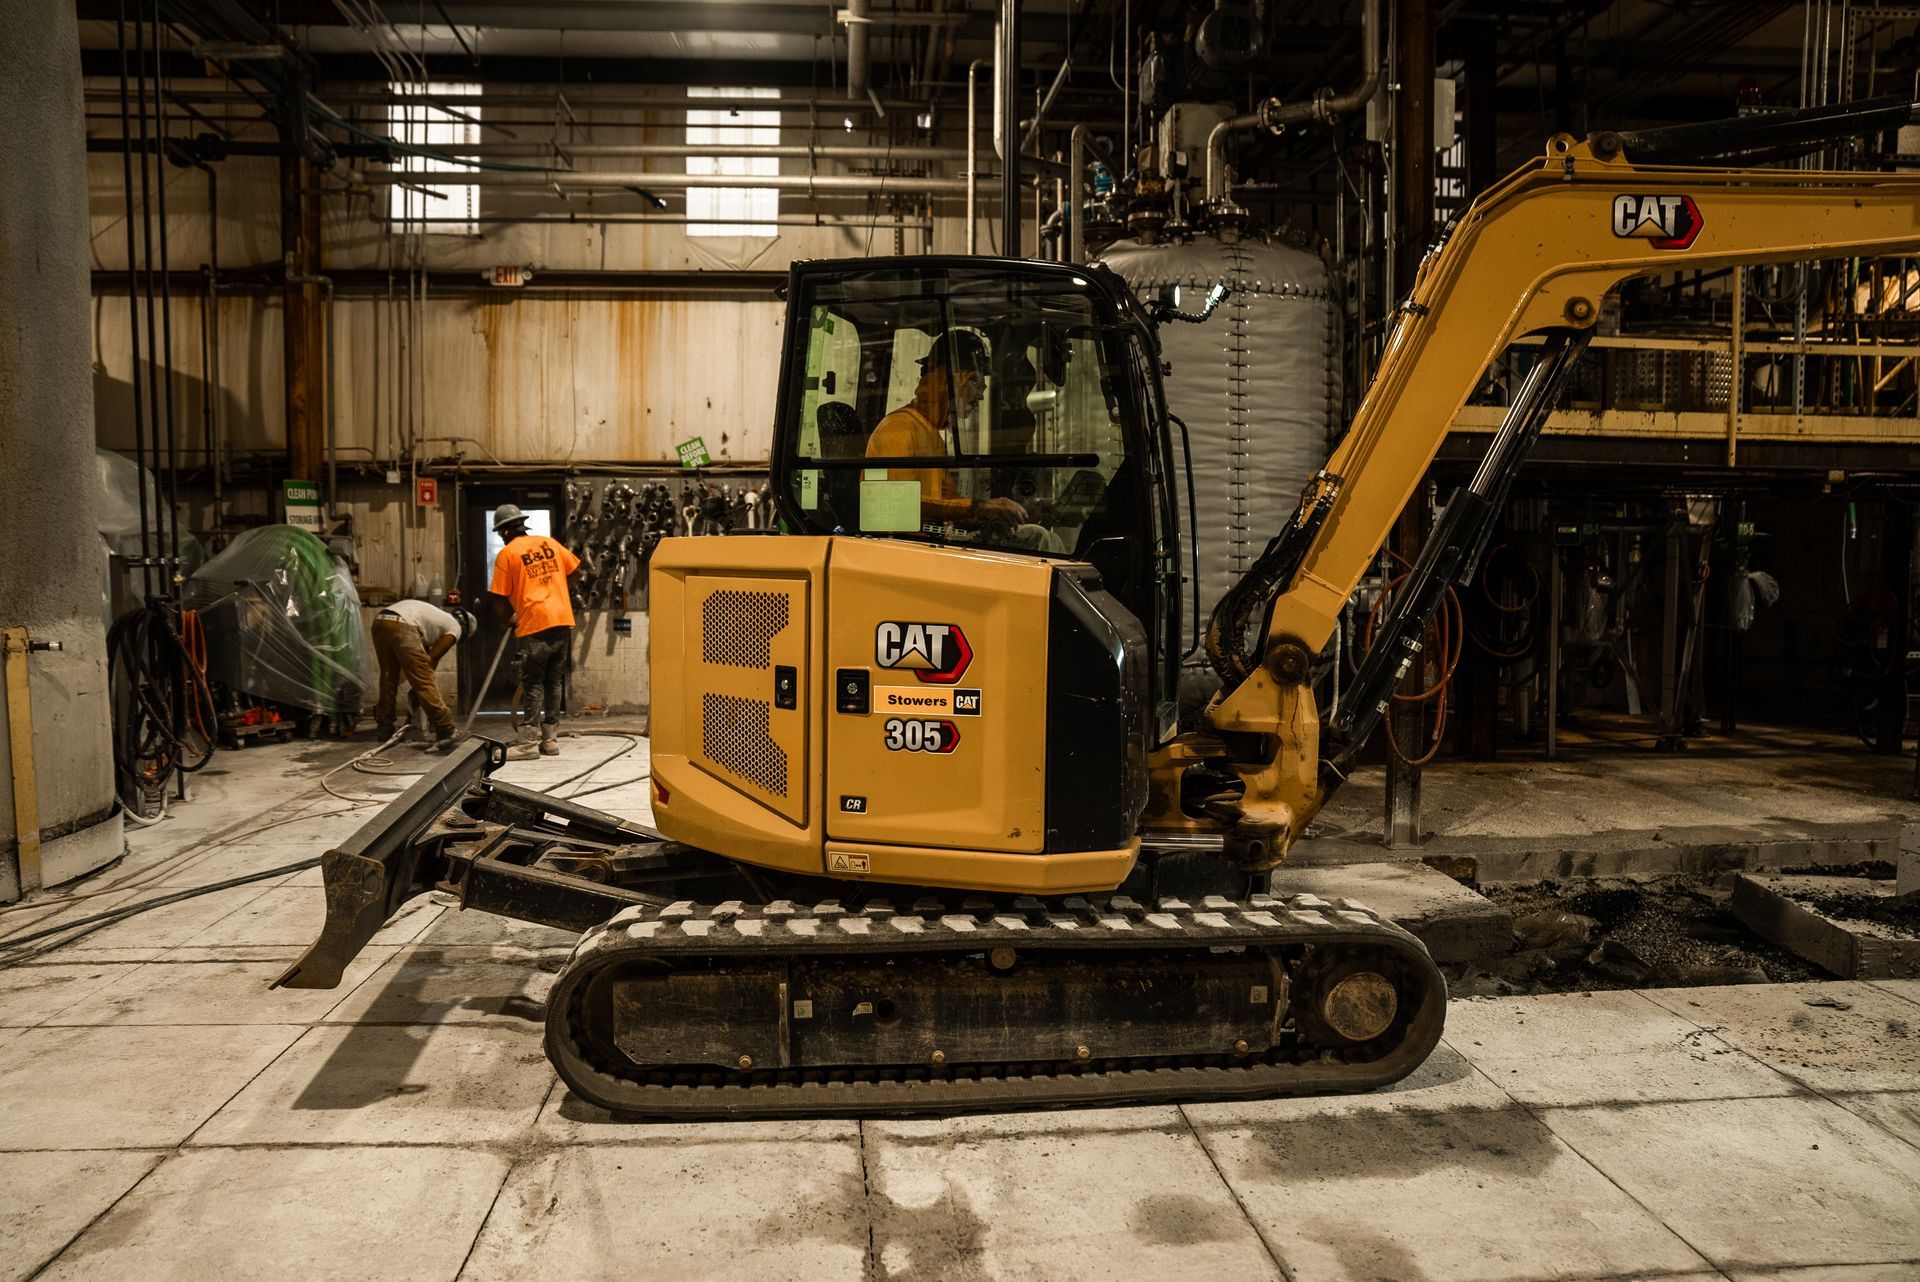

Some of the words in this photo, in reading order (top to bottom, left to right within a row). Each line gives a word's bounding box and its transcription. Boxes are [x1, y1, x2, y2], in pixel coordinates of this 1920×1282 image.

[1614, 195, 1682, 237] CAT
[495, 266, 519, 284] EXIT
[680, 439, 702, 455] CLEAN
[681, 446, 706, 463] BEFORE
[690, 456, 704, 467] USE
[287, 488, 306, 500] CLEAN
[289, 514, 312, 525] STORAGE
[521, 548, 555, 566] B&D
[877, 622, 949, 670] CAT
[888, 694, 948, 707] Stowers
[956, 696, 978, 709] CAT
[886, 719, 942, 751] 305
[845, 799, 862, 810] CR
